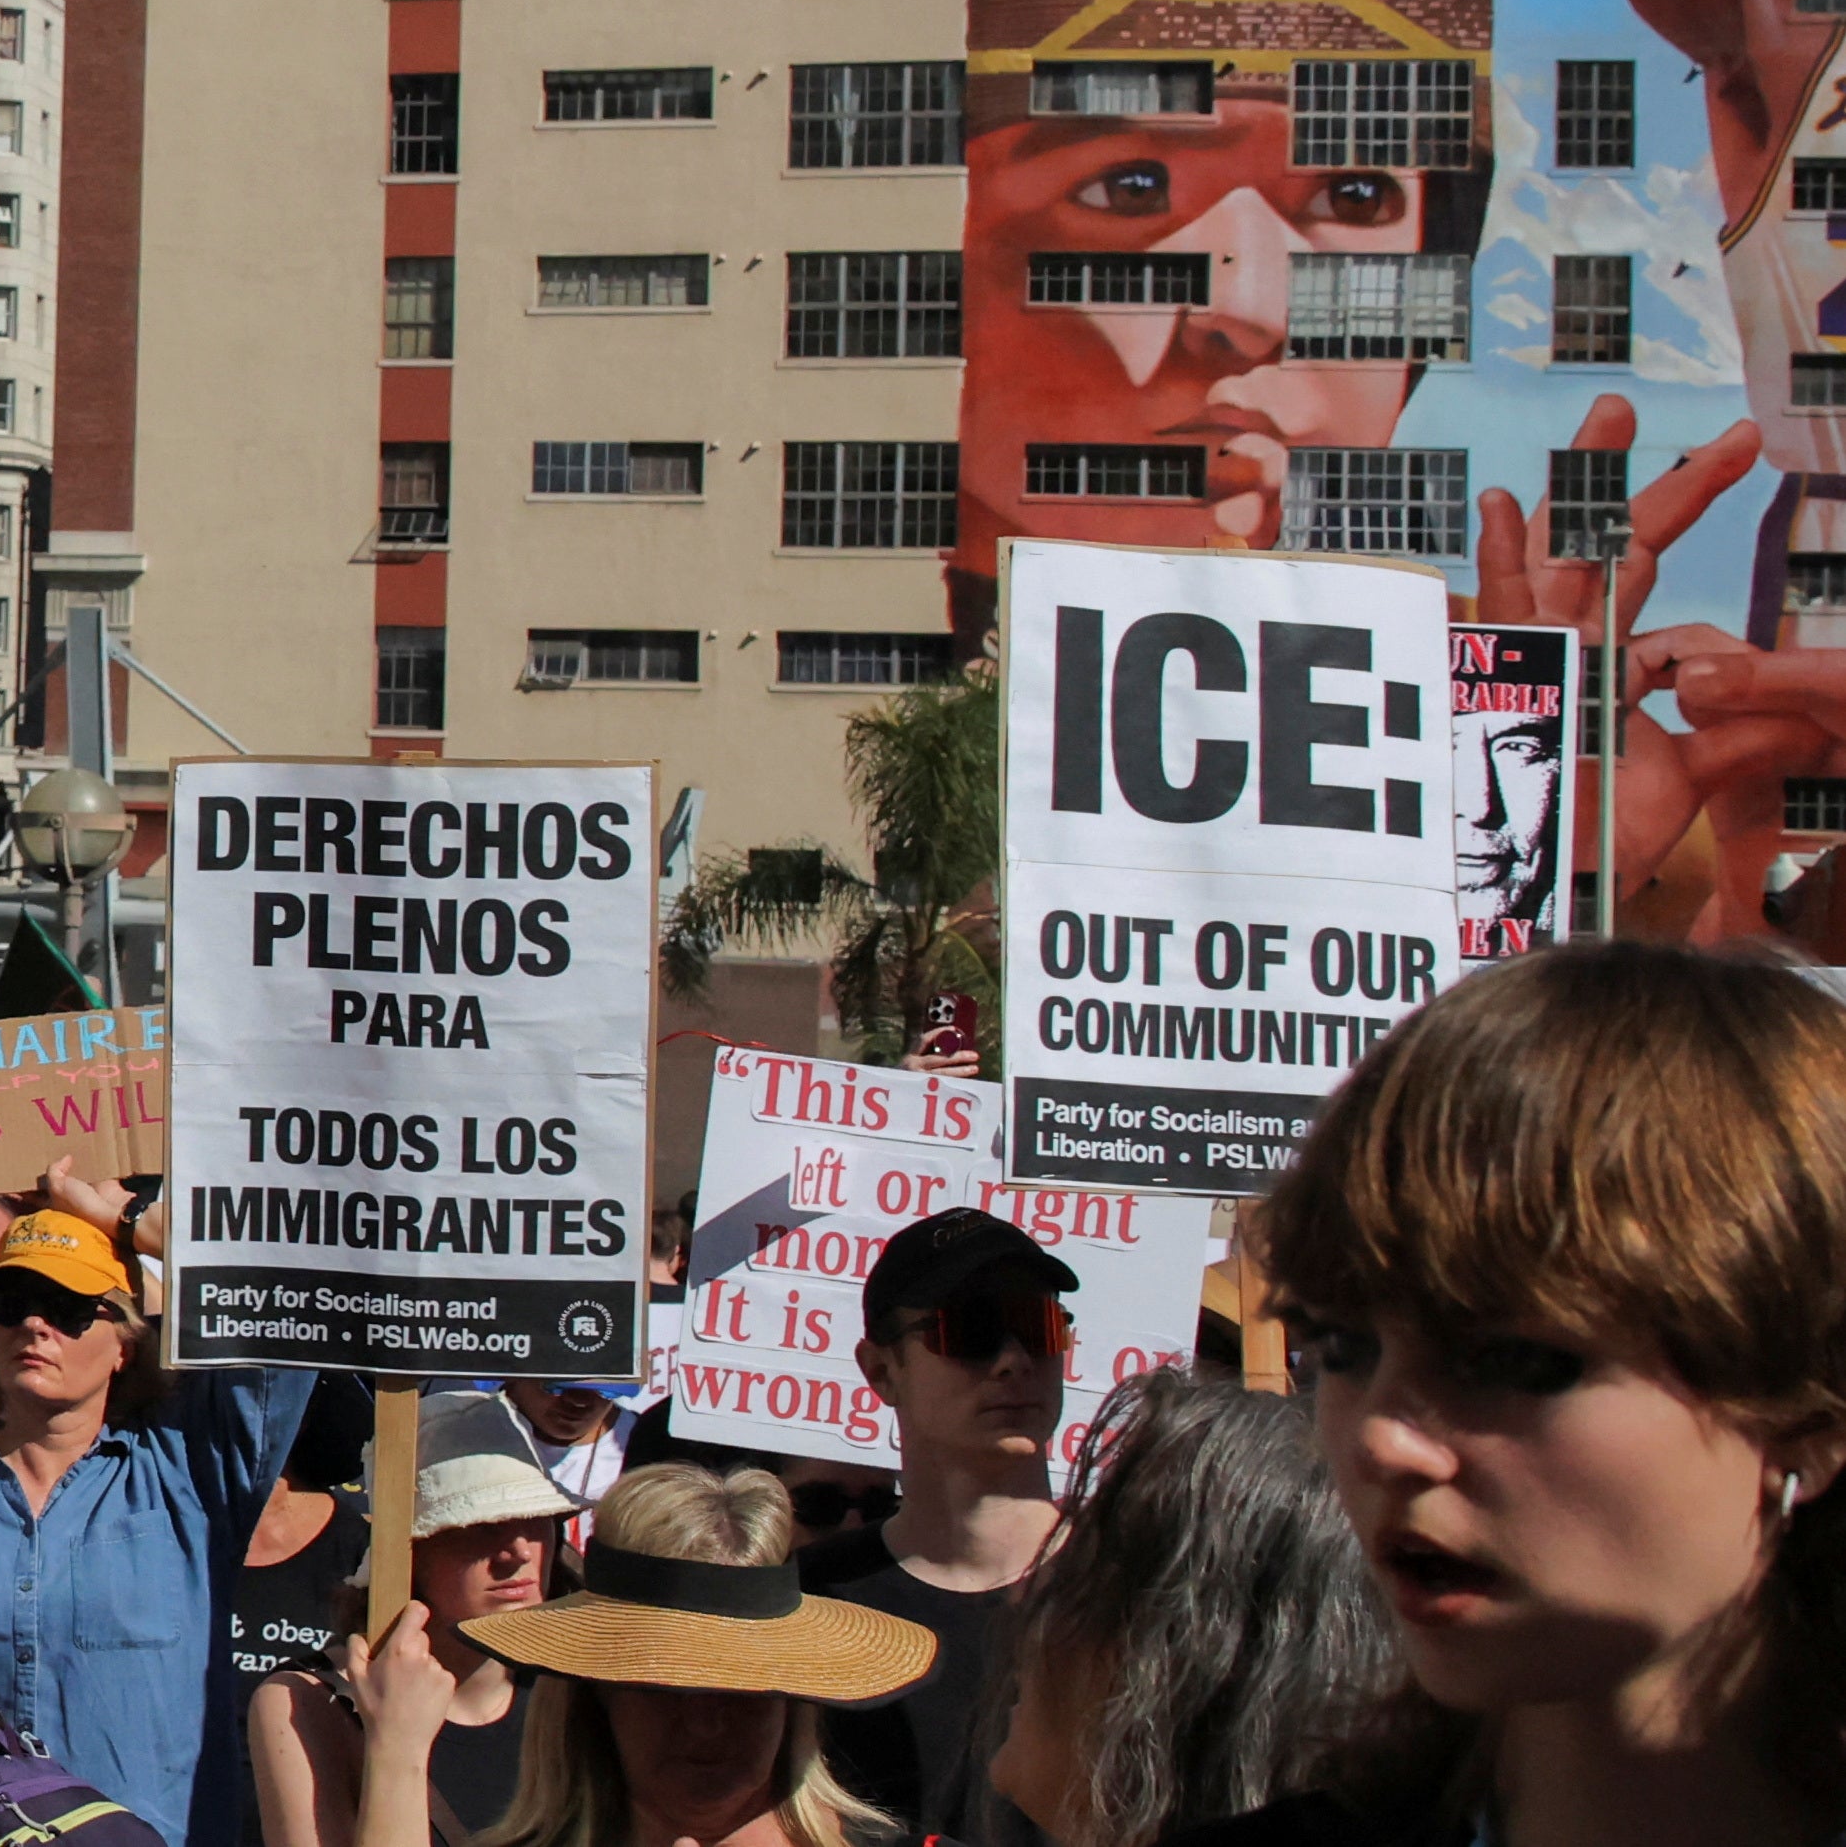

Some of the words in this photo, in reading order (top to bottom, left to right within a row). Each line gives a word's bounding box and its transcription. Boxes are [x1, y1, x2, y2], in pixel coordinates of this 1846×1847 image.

[1051, 604, 1423, 839] ICE:
[1452, 681, 1560, 717] RABLE
[197, 795, 632, 881] DERECHOS
[252, 891, 571, 977] PLENOS
[1039, 910, 1175, 987] OUT
[1195, 920, 1289, 992] OF
[1310, 927, 1437, 1004] OUR
[330, 989, 491, 1050] PARA
[239, 1106, 440, 1173] TODOS
[460, 1116, 578, 1176] LOS
[921, 1075, 975, 1142] is
[1037, 1097, 1104, 1132] Party
[1109, 1103, 1146, 1129] for
[1151, 1105, 1284, 1138] Socialism
[790, 1145, 848, 1209] left
[876, 1168, 947, 1219] or
[1036, 1132, 1165, 1165] Liberation
[190, 1185, 626, 1257] IMMIGRANTES
[200, 1283, 268, 1312] Party
[273, 1284, 309, 1309] for
[314, 1287, 439, 1319] Socialism
[445, 1296, 497, 1321] and
[200, 1316, 328, 1342] Liberation
[366, 1326, 531, 1358] PSLWeb.org
[701, 1279, 751, 1342] It
[783, 1290, 835, 1354] is
[682, 1363, 881, 1443] wrong
[262, 1617, 334, 1652] obey
